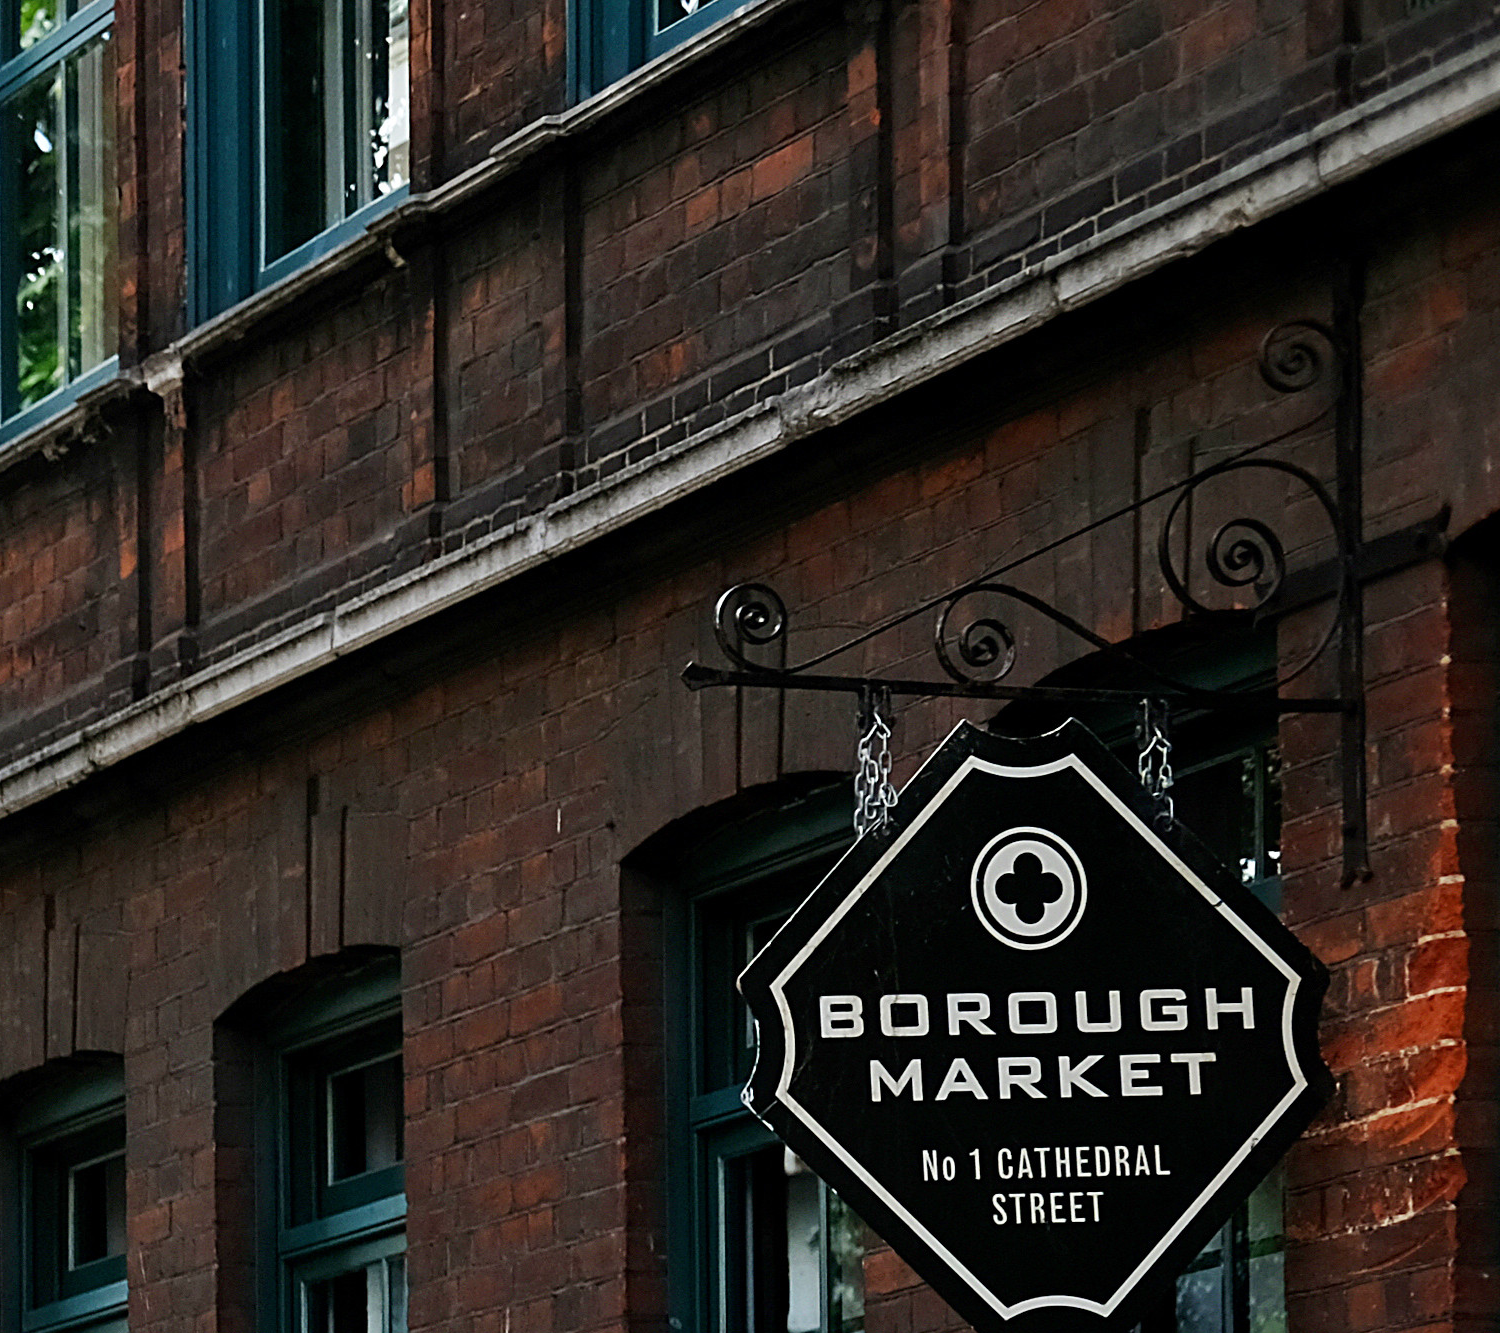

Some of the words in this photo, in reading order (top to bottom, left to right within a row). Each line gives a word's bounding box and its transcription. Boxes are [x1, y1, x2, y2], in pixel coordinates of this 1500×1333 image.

[818, 986, 1256, 1039] BOROUGH
[870, 1051, 1218, 1103] MARKET
[922, 1147, 957, 1182] No
[969, 1146, 983, 1180] 1
[996, 1143, 1171, 1180] CATHEDRAL
[991, 1190, 1105, 1226] STREET
